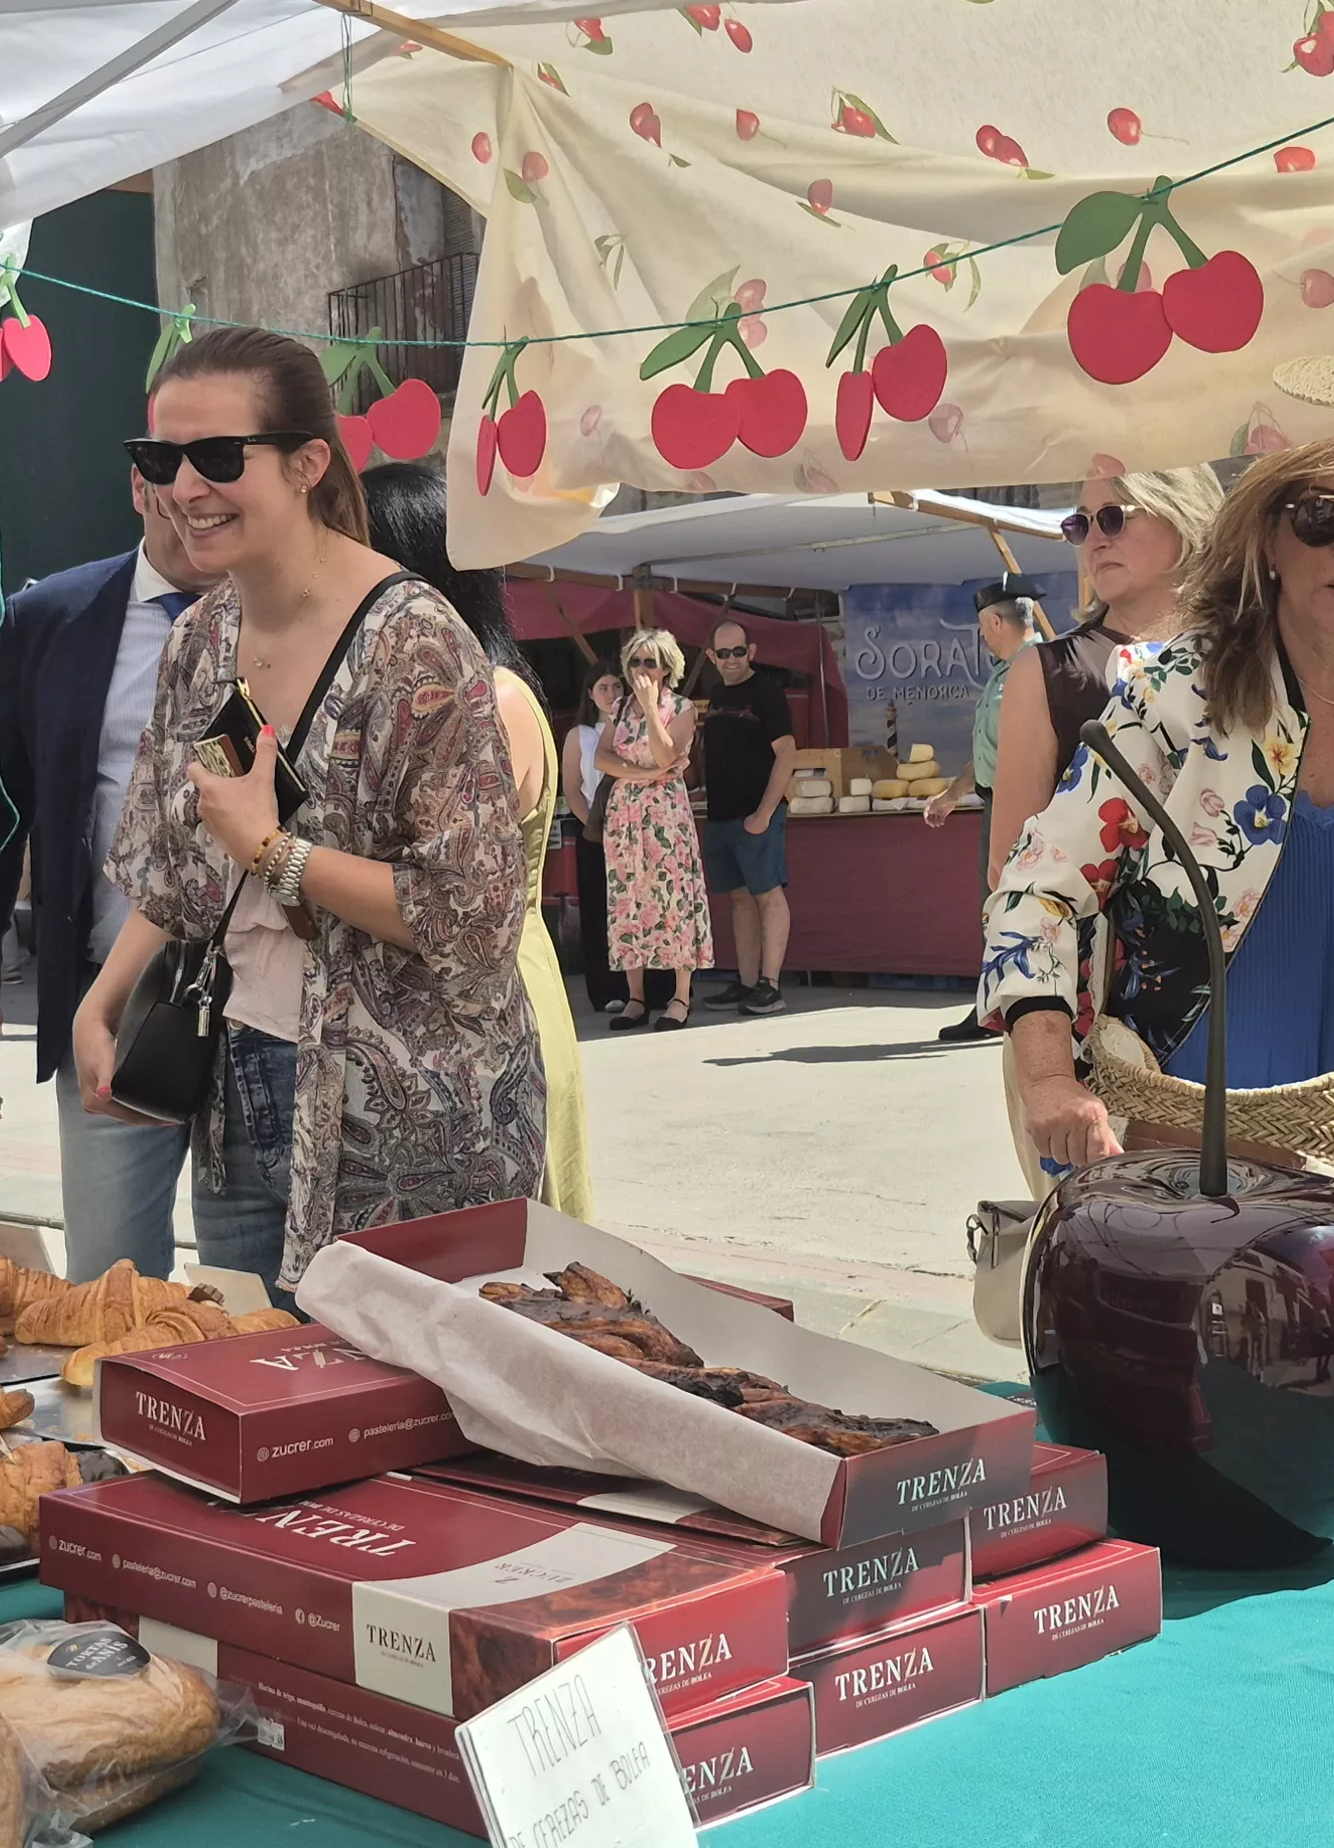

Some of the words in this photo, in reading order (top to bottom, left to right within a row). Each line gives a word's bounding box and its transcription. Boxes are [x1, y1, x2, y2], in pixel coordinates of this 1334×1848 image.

[855, 618, 1001, 692] SORAT
[867, 687, 887, 701] DE
[893, 684, 970, 703] MENORCA
[136, 1391, 206, 1441] TRENZA
[271, 1436, 334, 1458] zucrer.com
[897, 1457, 986, 1505] TRENZA
[235, 1509, 416, 1556] TREN
[983, 1485, 1067, 1531] TRENZA
[823, 1547, 919, 1598] TRENZA
[1034, 1584, 1120, 1635] TRENZA
[366, 1623, 436, 1662] TRENZA
[645, 1633, 733, 1684] RENZA
[835, 1647, 934, 1701] TRENZA
[507, 1674, 602, 1777] TRENZA
[681, 1746, 754, 1795] ENZA
